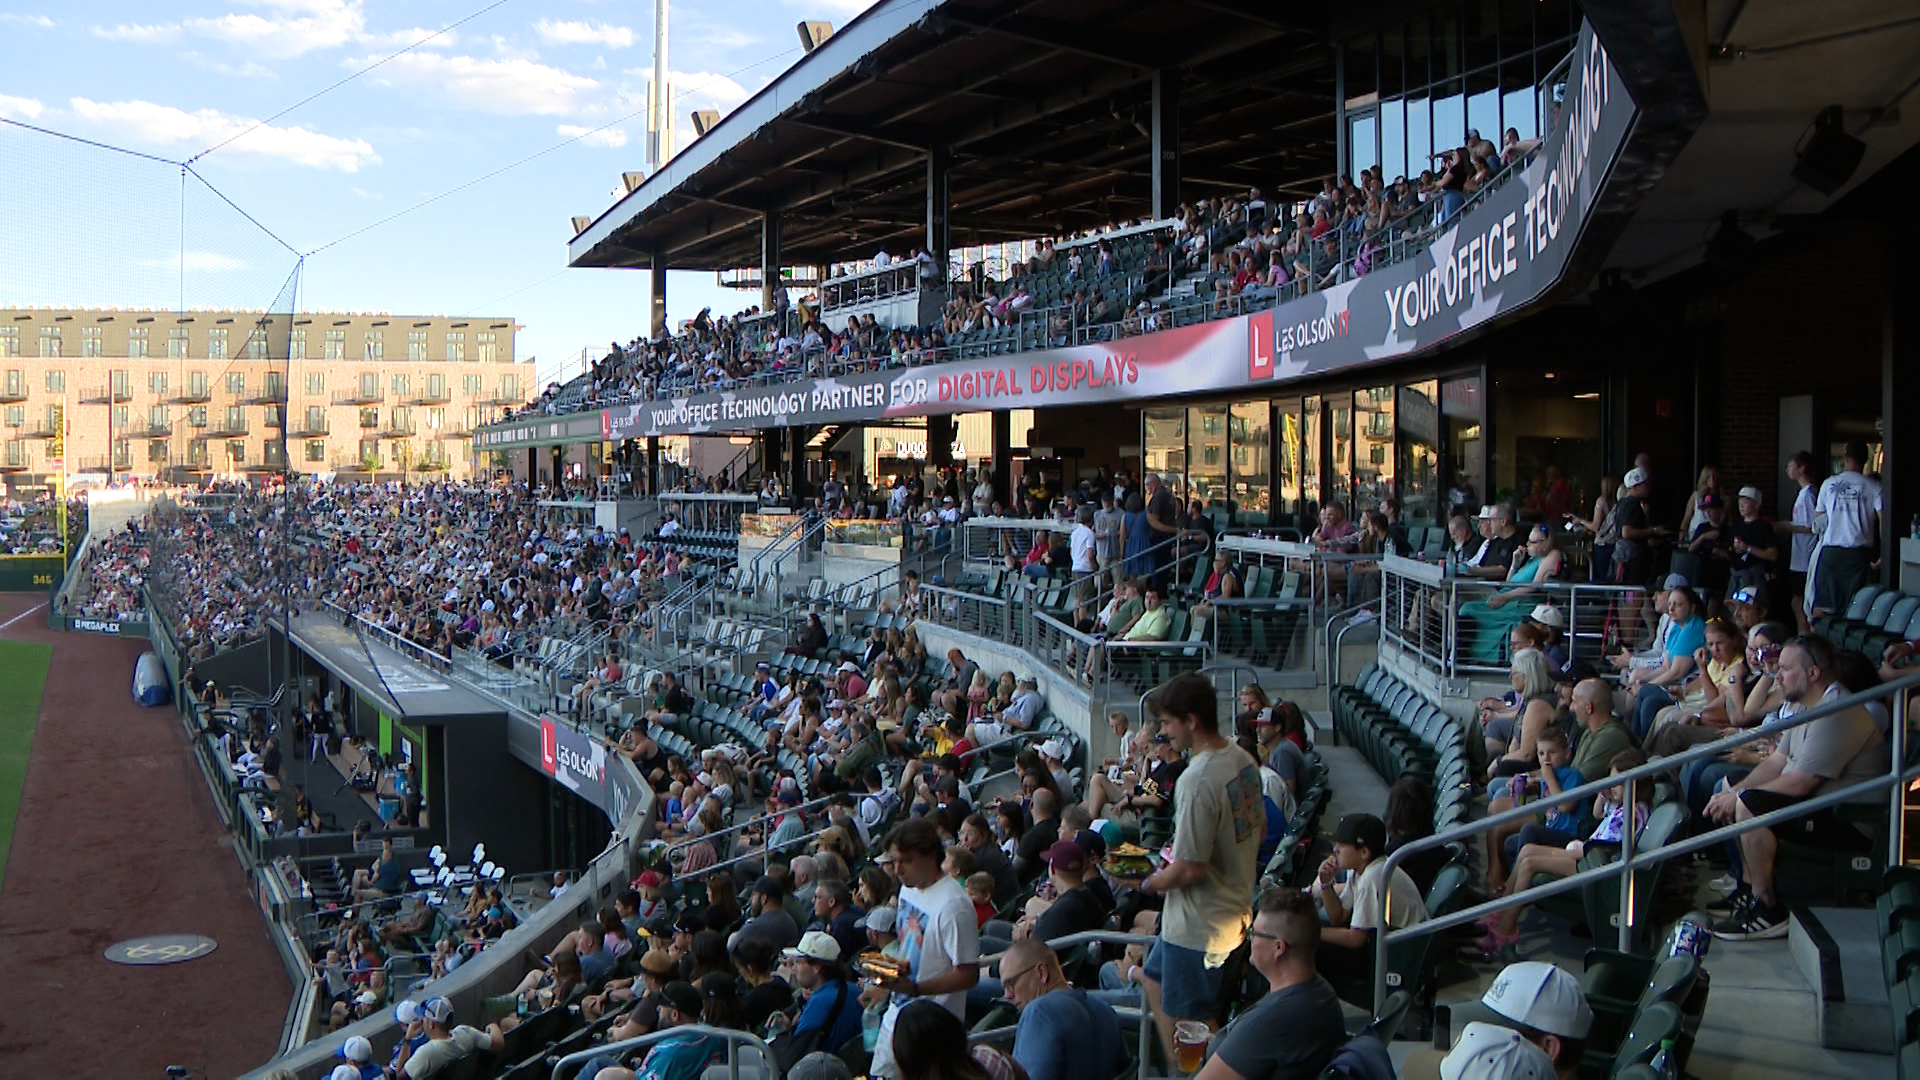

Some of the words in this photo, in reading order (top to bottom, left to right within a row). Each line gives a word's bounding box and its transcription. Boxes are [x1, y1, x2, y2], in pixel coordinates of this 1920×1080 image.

[1385, 266, 1440, 333] YOUR
[1445, 211, 1517, 307] OFFICE
[1254, 323, 1269, 368] L
[1275, 326, 1295, 353] LES
[1296, 313, 1335, 348] OLSON
[651, 409, 677, 427] YOUR
[680, 402, 719, 424] OFFICE
[721, 391, 808, 421] TECHNOLOGY
[812, 382, 885, 413] PARTNER
[890, 378, 928, 406] FOR
[938, 366, 1023, 401] DIGITAL
[1030, 351, 1139, 394] DISPLAYS
[543, 727, 553, 764] L
[556, 743, 570, 766] LES
[570, 751, 599, 782] OLSON
